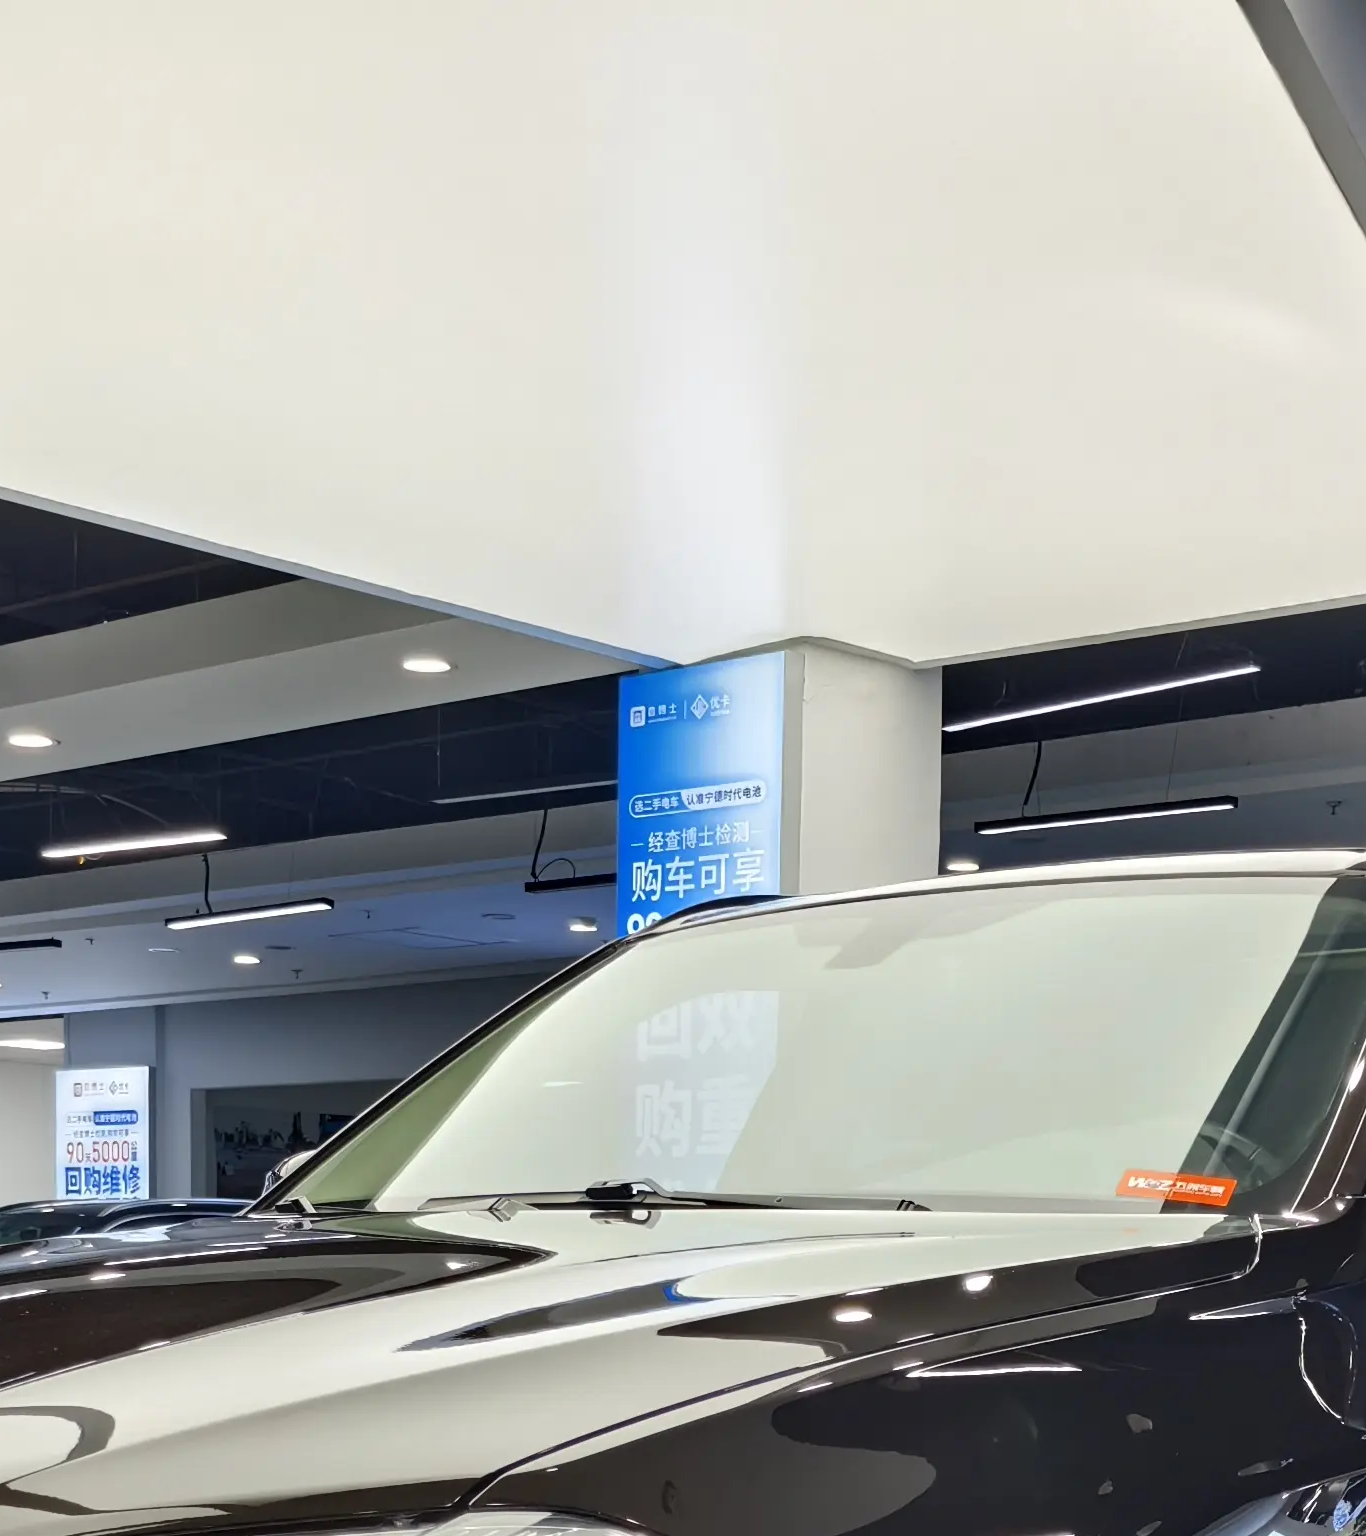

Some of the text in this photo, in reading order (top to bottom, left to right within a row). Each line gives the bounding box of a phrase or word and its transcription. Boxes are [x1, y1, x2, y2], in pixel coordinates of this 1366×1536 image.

[647, 820, 750, 853] 经查博士检测
[631, 848, 765, 903] 购车可享
[65, 1165, 140, 1195] 回购维修
